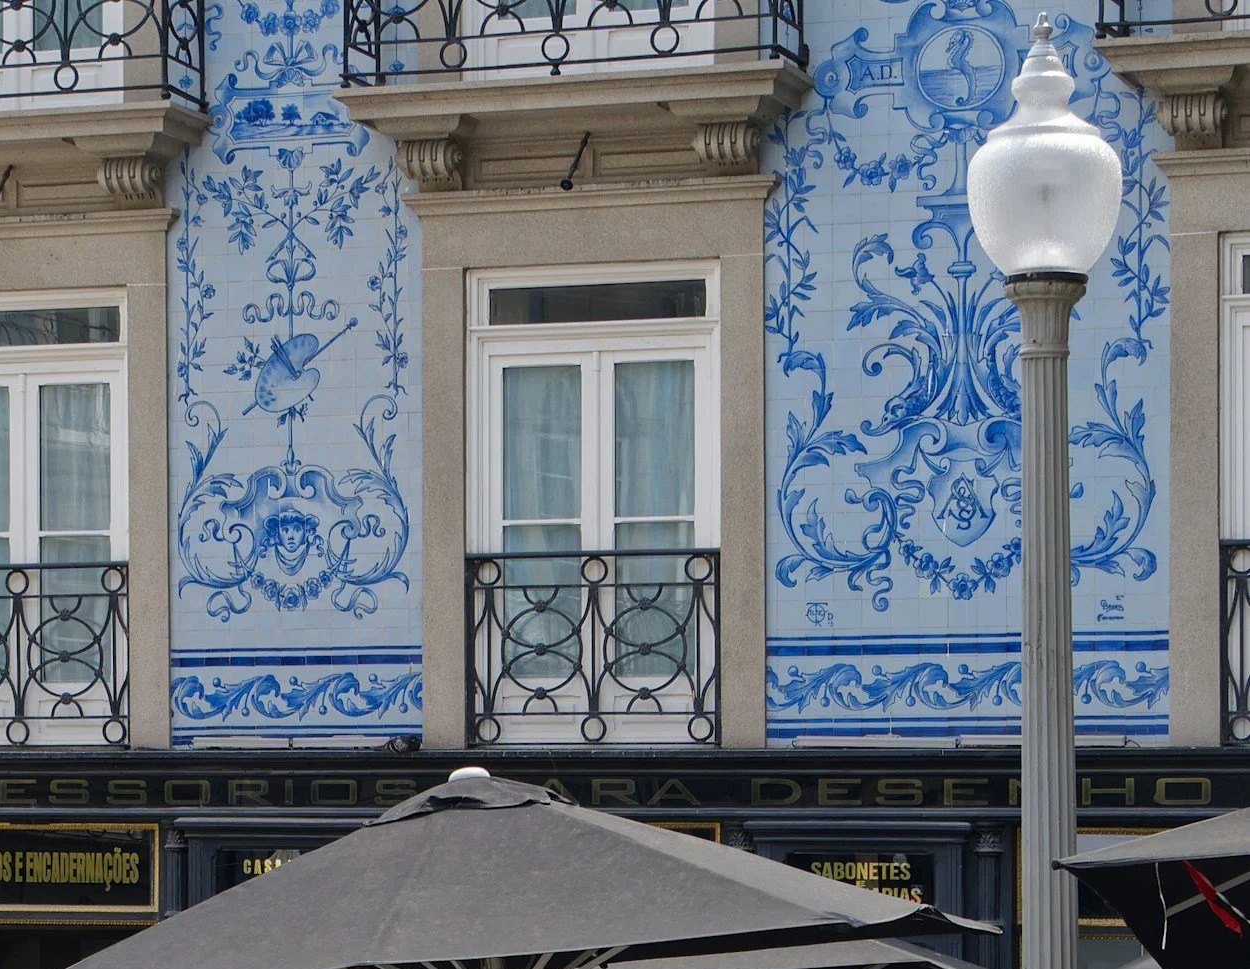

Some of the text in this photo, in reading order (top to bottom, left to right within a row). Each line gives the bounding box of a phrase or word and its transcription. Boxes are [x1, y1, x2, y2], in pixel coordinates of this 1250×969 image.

[860, 65, 897, 81] A.D.
[541, 778, 700, 806] ARA
[15, 852, 23, 883] E
[26, 847, 139, 892] ENCADERNAÇÕES
[811, 862, 911, 880] SABONETES
